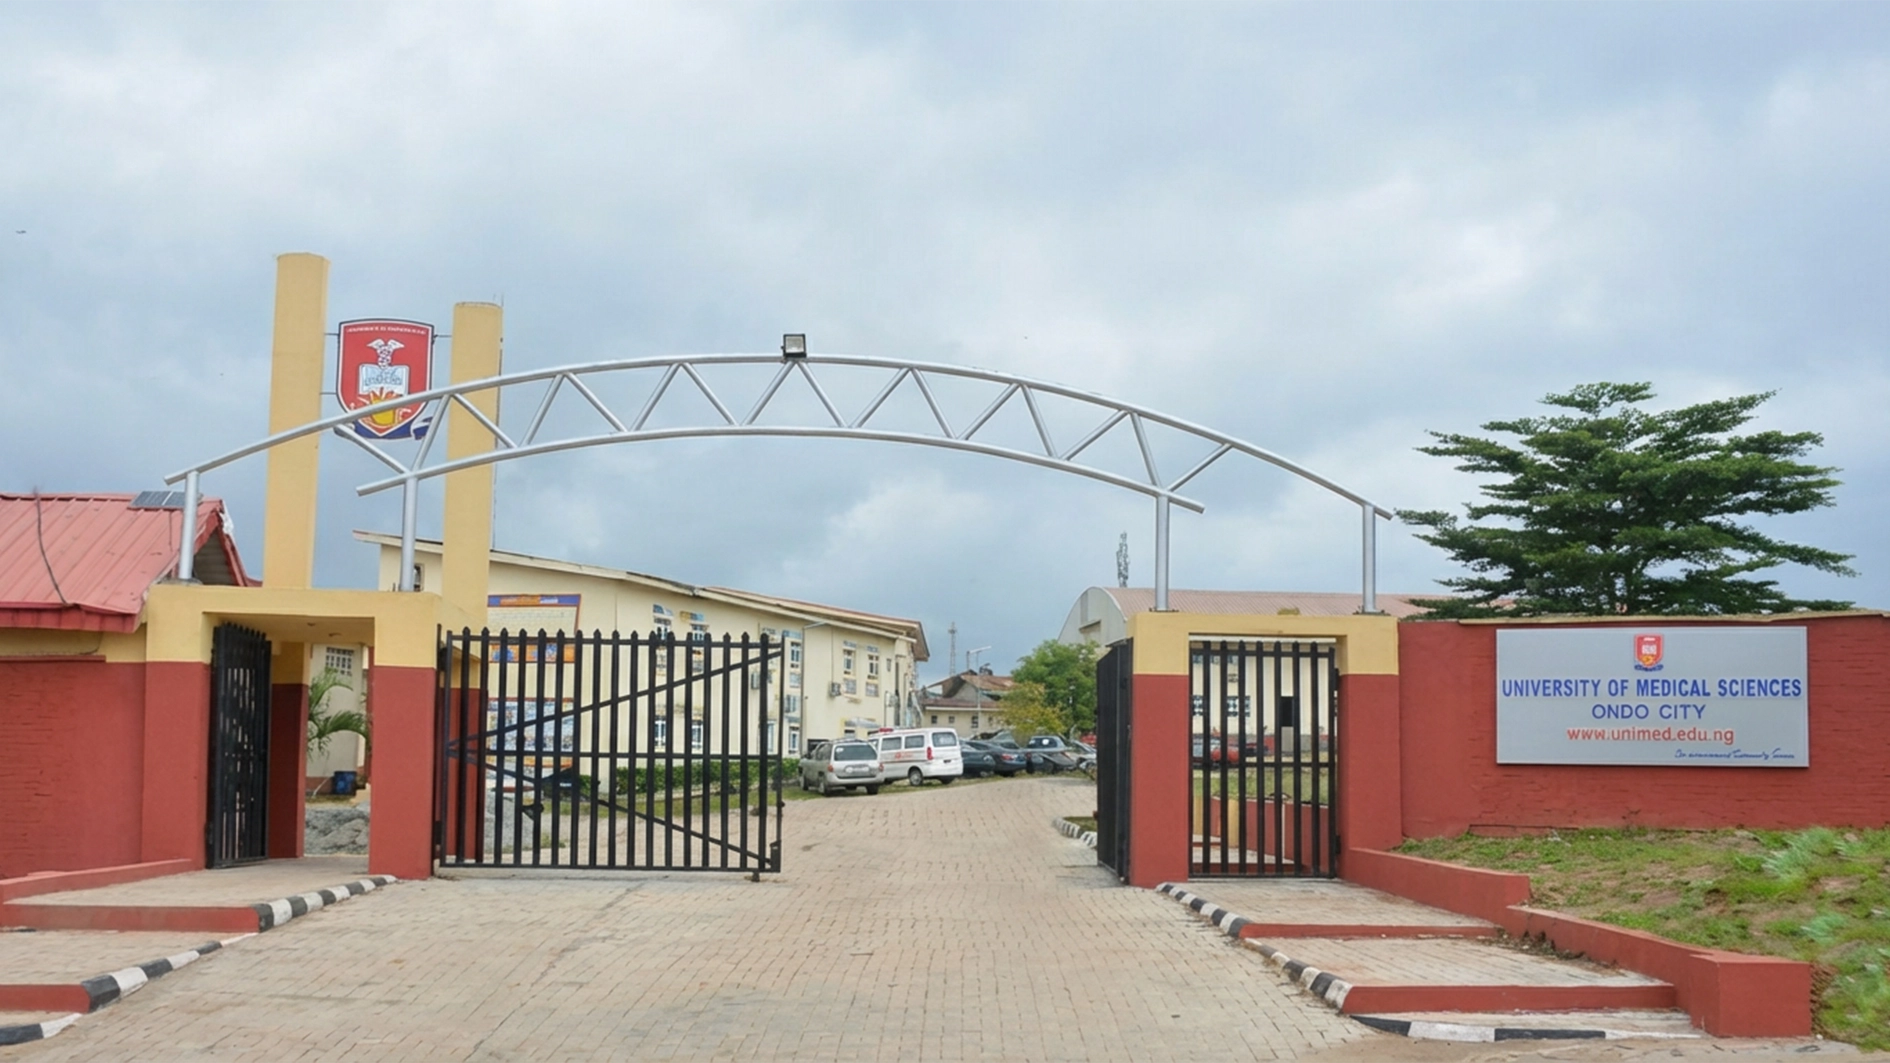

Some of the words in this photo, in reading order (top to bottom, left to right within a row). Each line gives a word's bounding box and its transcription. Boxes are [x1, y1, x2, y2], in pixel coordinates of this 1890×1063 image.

[1502, 679, 1601, 697] UNIVERSITY
[1608, 679, 1629, 697] OF
[1636, 679, 1711, 697] MEDICAL
[1718, 679, 1802, 697] SCIENCES
[1591, 704, 1650, 720] ONDO
[1659, 704, 1706, 720] CITY
[1567, 726, 1735, 746] www.unimed.edu.ng
